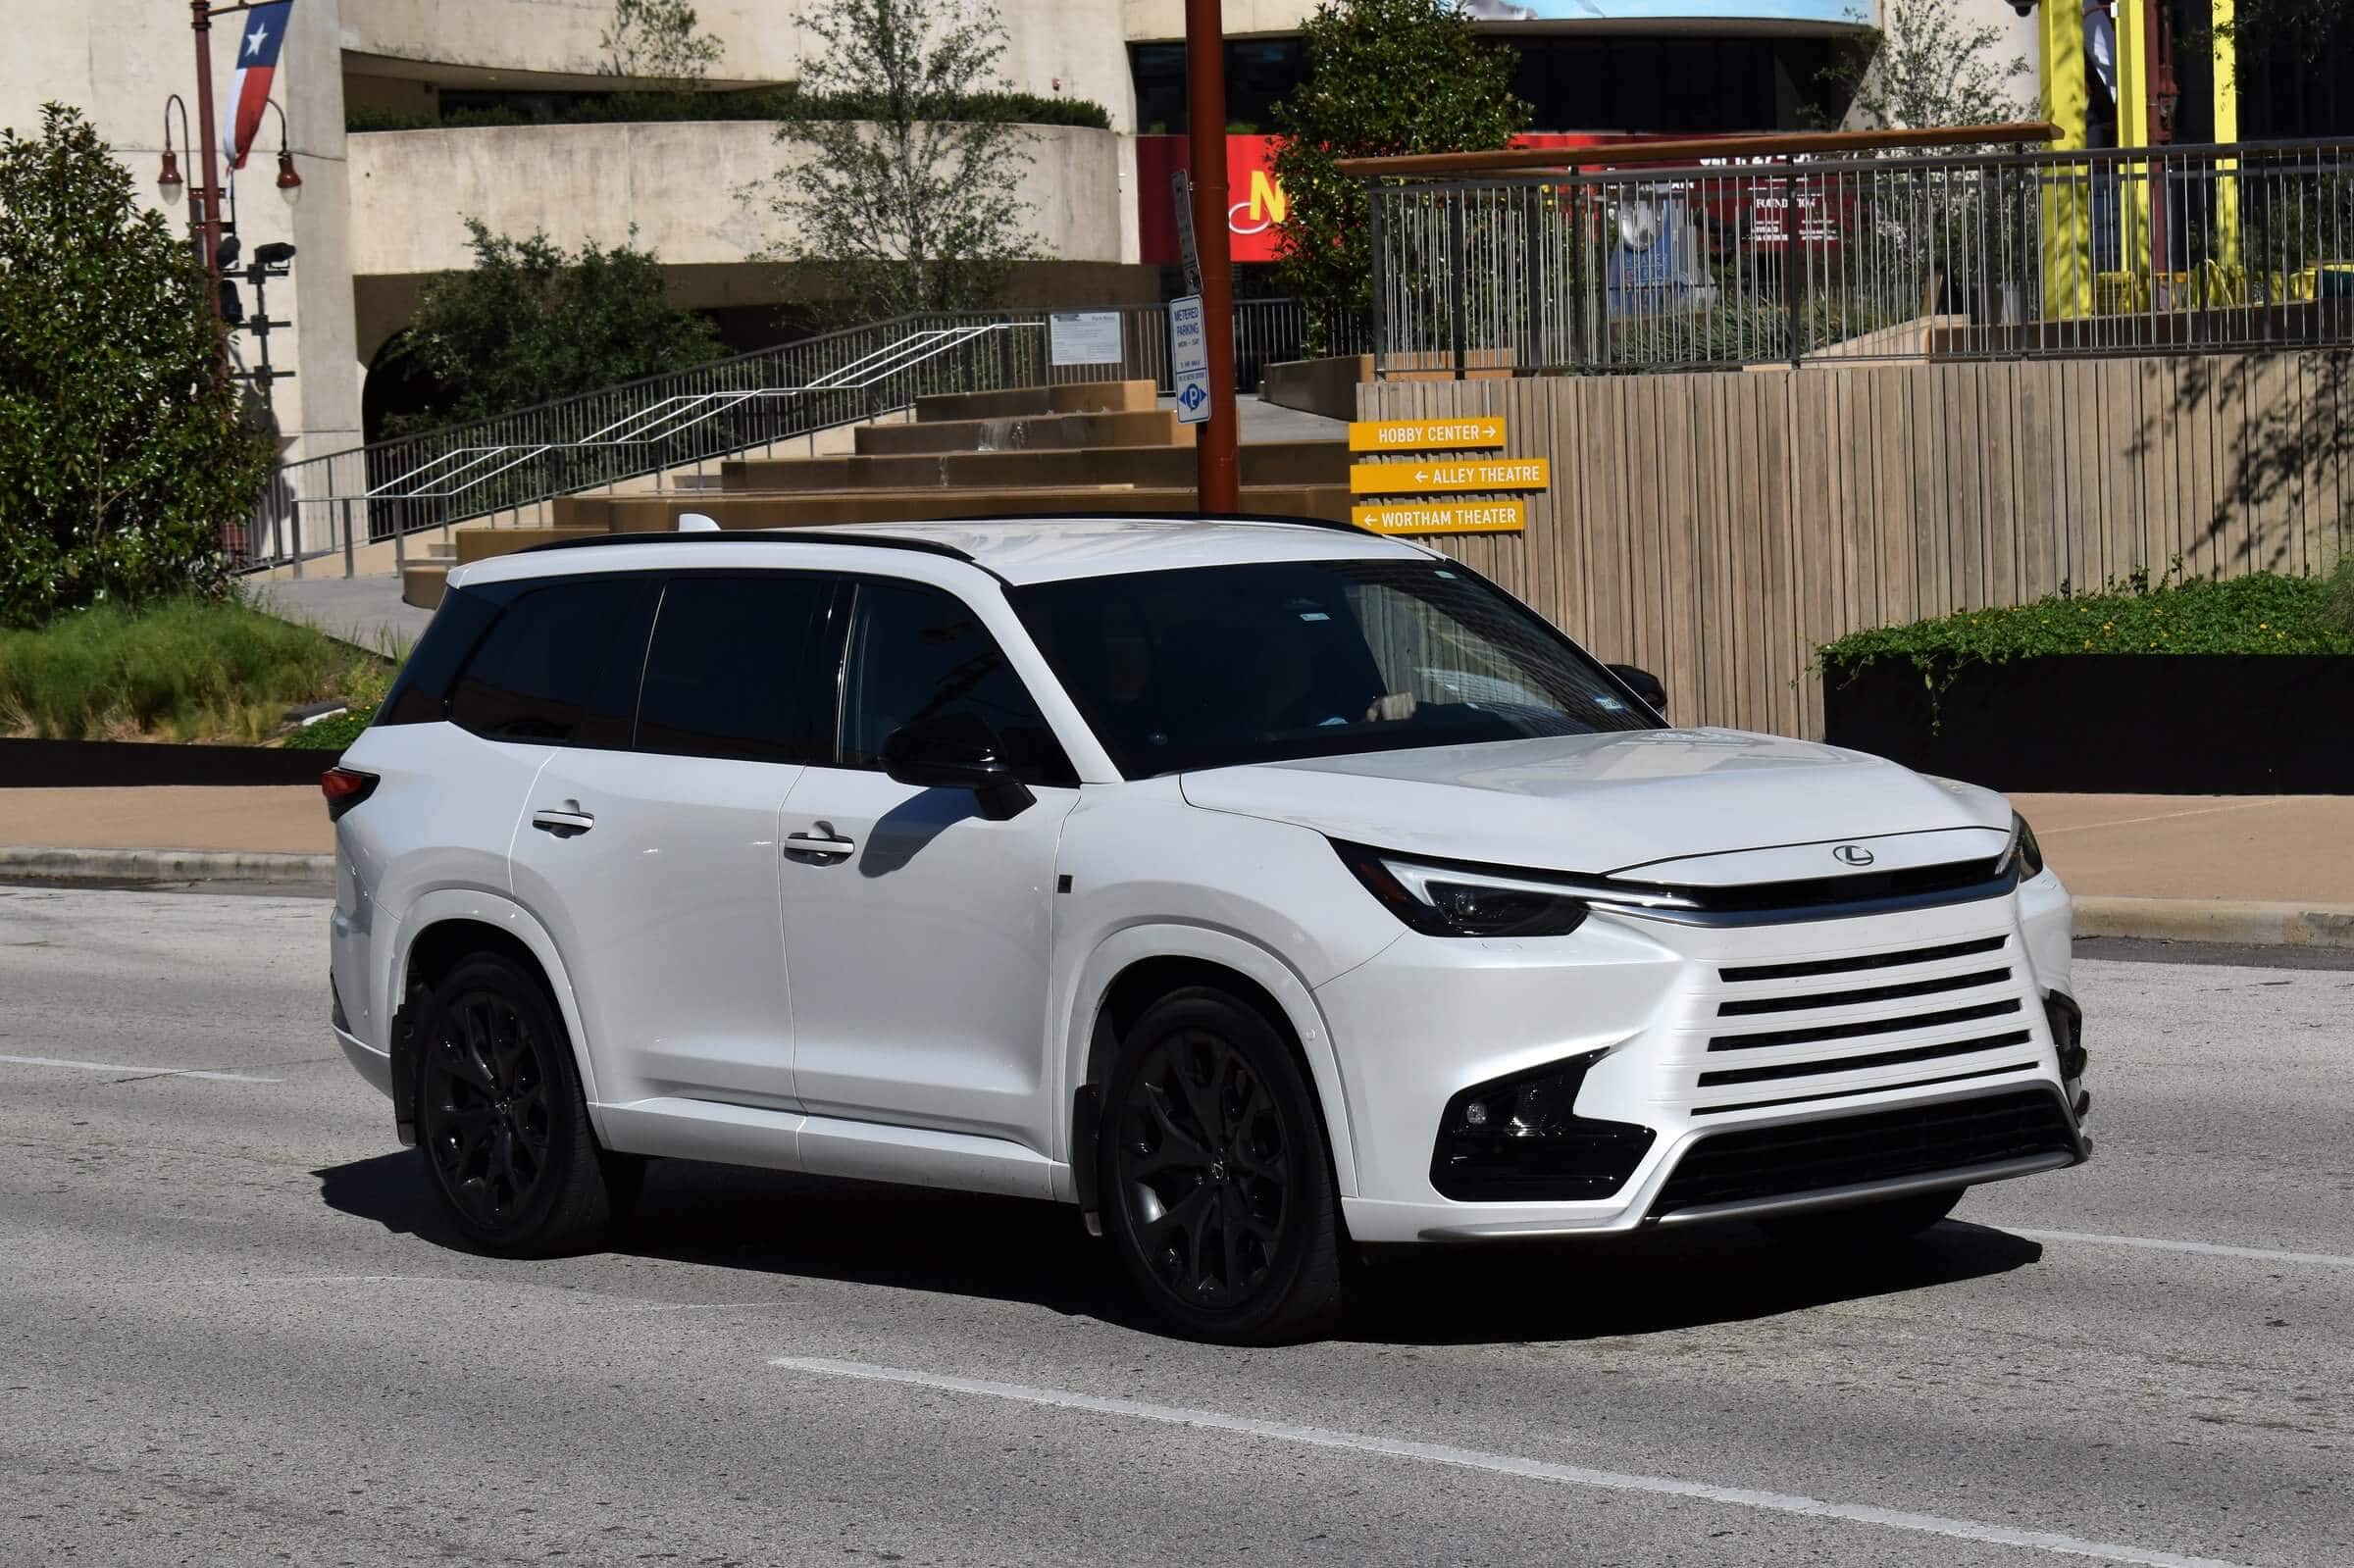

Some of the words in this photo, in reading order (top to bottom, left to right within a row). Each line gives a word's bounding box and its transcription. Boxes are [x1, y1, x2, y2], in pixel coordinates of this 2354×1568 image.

[1174, 307, 1199, 323] METERED
[1176, 324, 1200, 337] PARKING
[1378, 427, 1423, 443] HOBBY
[1428, 425, 1479, 441] CENTER
[1432, 468, 1475, 484] ALLEY
[1479, 465, 1540, 482] THEATRE
[1382, 510, 1452, 528] WORTHAM
[1456, 508, 1516, 525] THEATER
